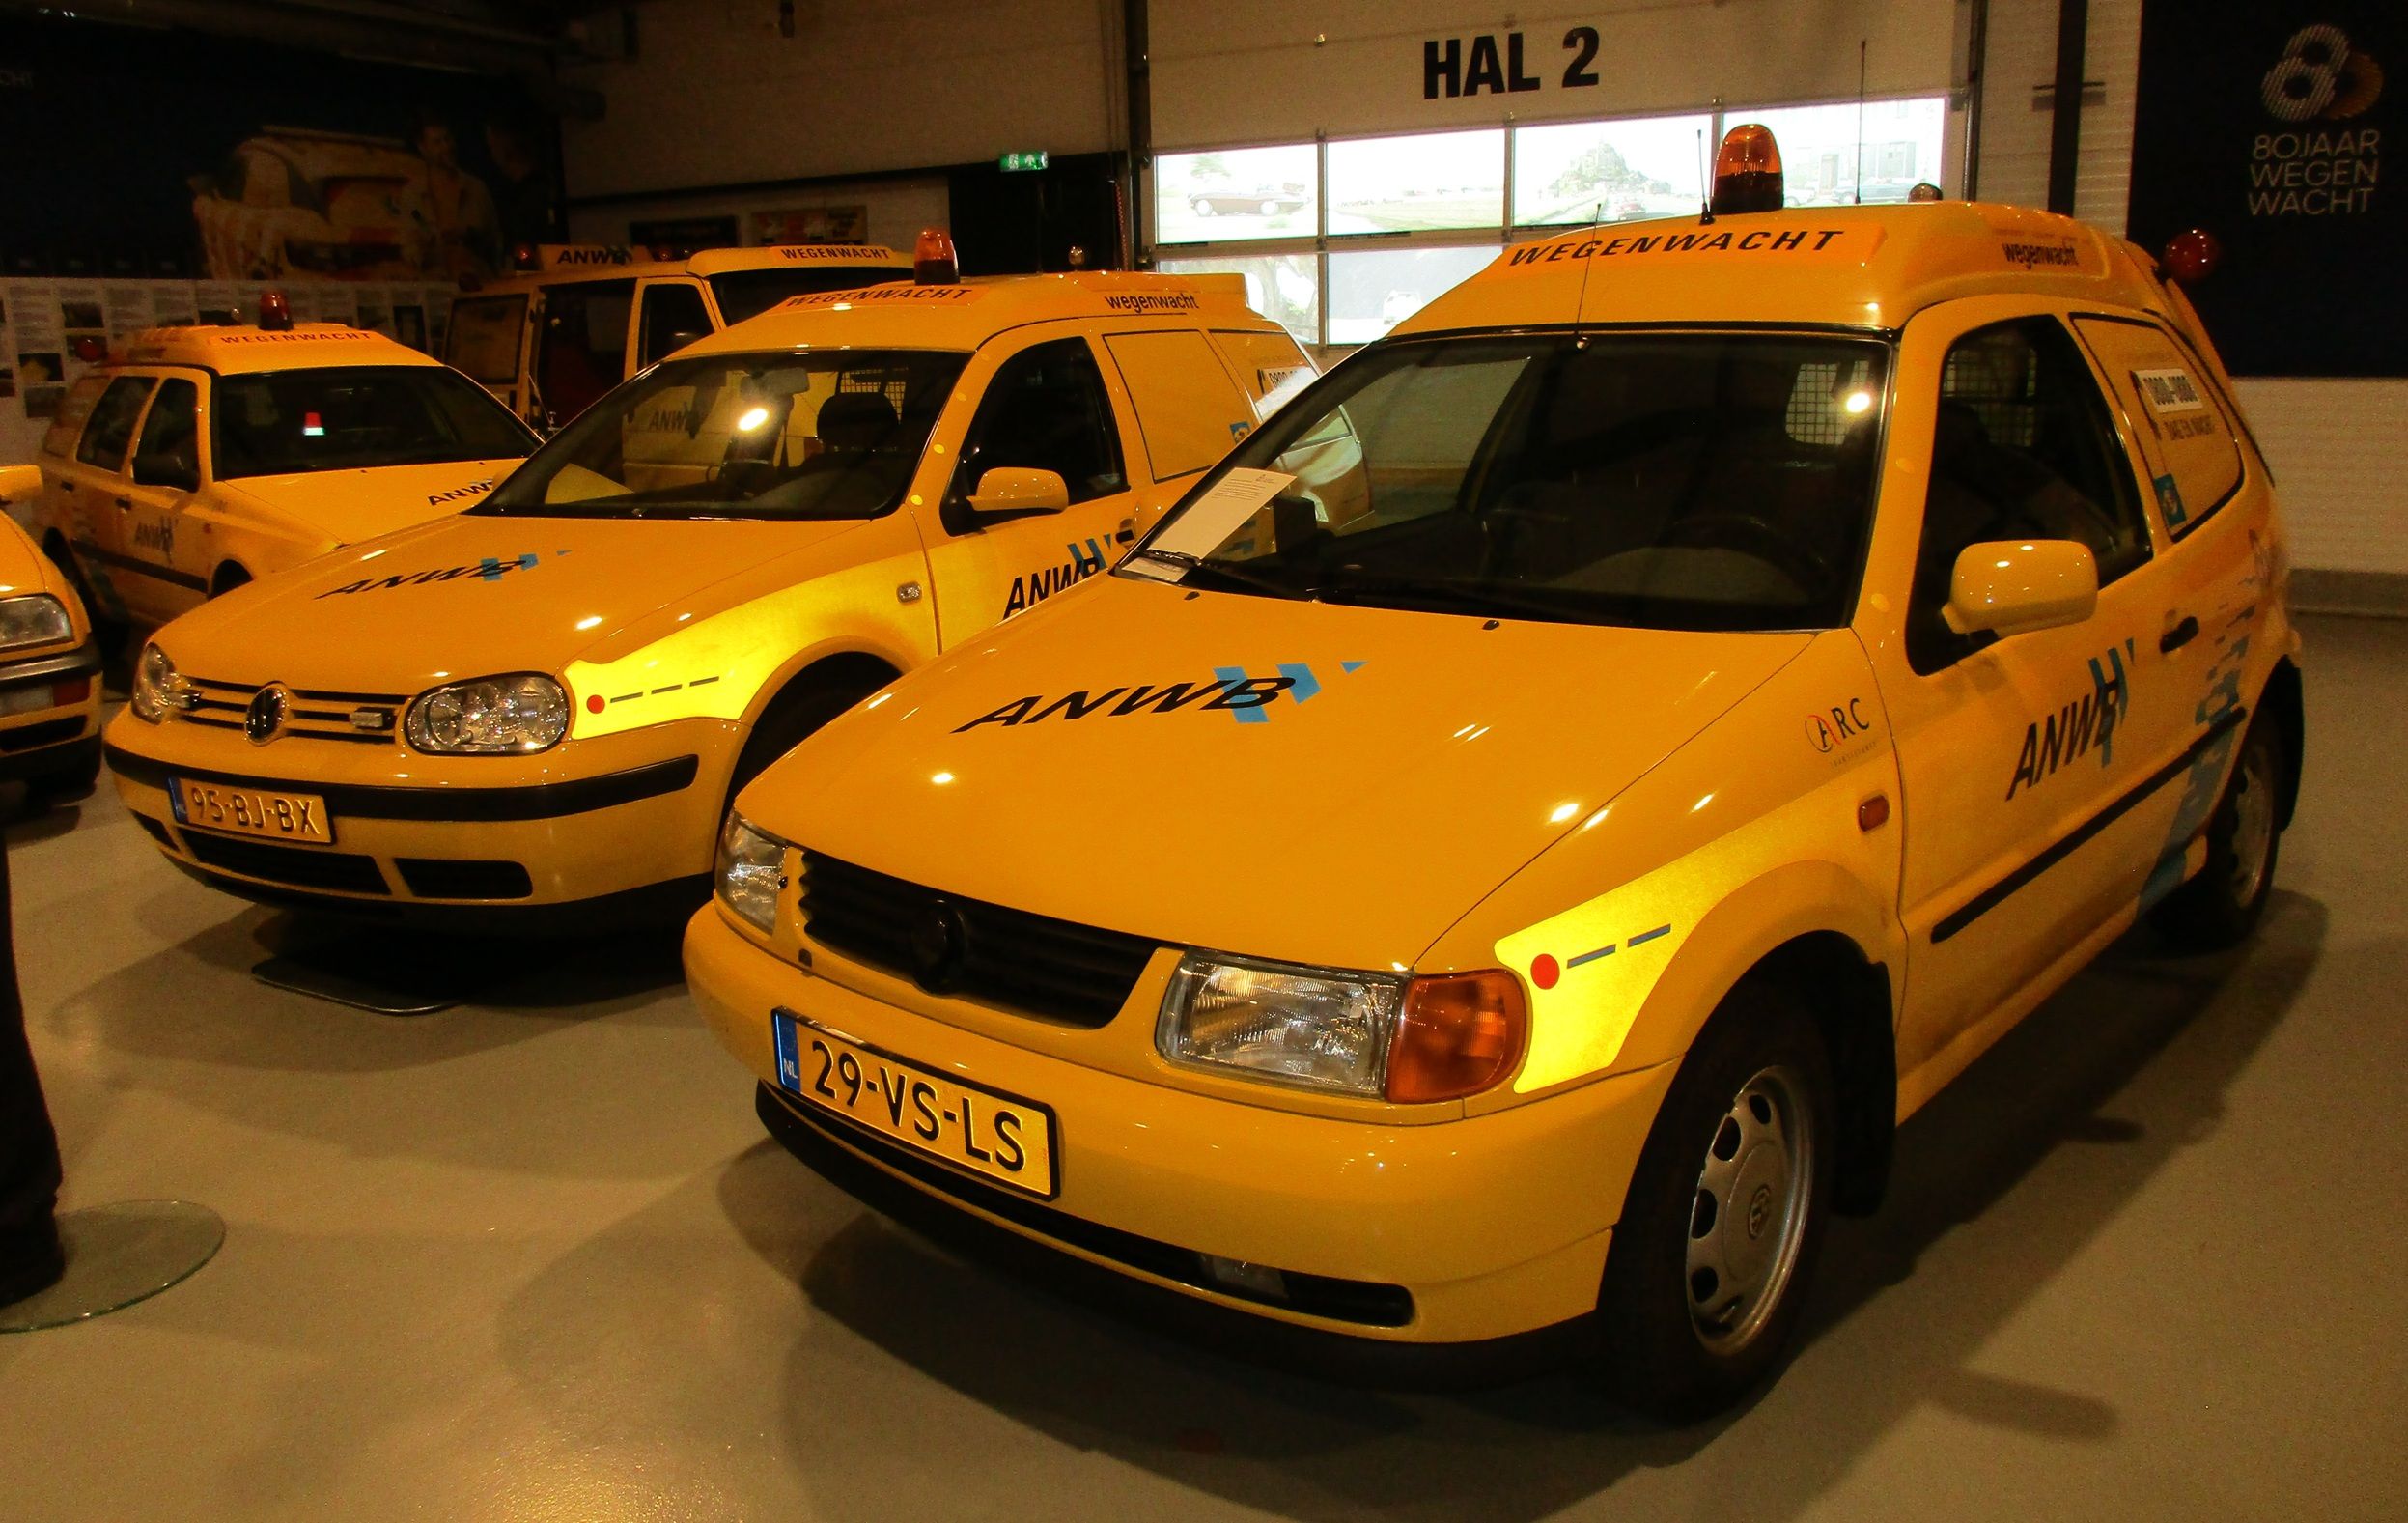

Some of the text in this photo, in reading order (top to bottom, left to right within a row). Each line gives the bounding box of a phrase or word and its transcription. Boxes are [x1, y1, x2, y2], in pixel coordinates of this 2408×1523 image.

[1424, 26, 1600, 99] HAL 2
[2249, 158, 2380, 188] WEGEN
[2248, 186, 2375, 216] WACHT
[780, 245, 890, 260] WEGENWACHT
[1509, 230, 1844, 267] WEGENWACHT
[2002, 243, 2079, 269] wegenwacht
[787, 289, 973, 307] WEGENWACHT
[1104, 292, 1199, 313] wegenwacht
[220, 332, 371, 344] WEGENWACHT
[313, 560, 527, 600] ANWB
[949, 677, 1297, 734] ANWB
[2005, 678, 2120, 803] ANWB
[192, 787, 321, 834] 95-BJ-BX
[783, 1058, 798, 1079] NL
[812, 1040, 1026, 1172] 29-VS-LS
